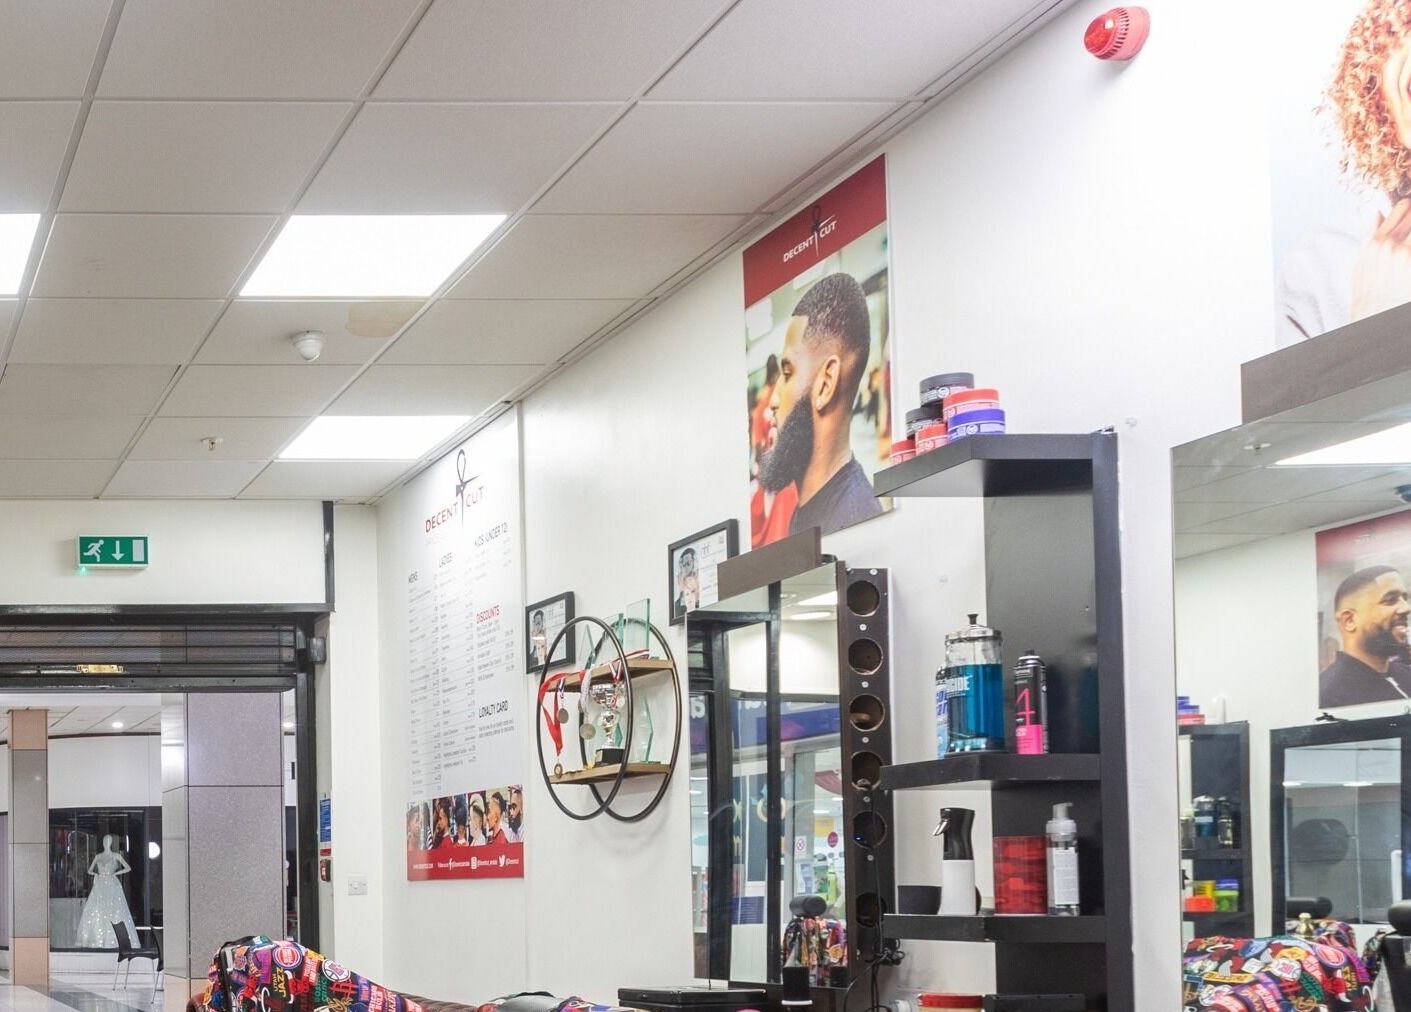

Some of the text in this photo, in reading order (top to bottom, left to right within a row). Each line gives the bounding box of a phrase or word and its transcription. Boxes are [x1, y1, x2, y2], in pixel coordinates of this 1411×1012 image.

[783, 219, 838, 263] DECENT CUT
[425, 486, 484, 533] DECENT CUT
[476, 605, 500, 625] DISCOUNTS
[478, 700, 508, 719] LOYALTY CARD
[278, 967, 287, 998] JAZZ
